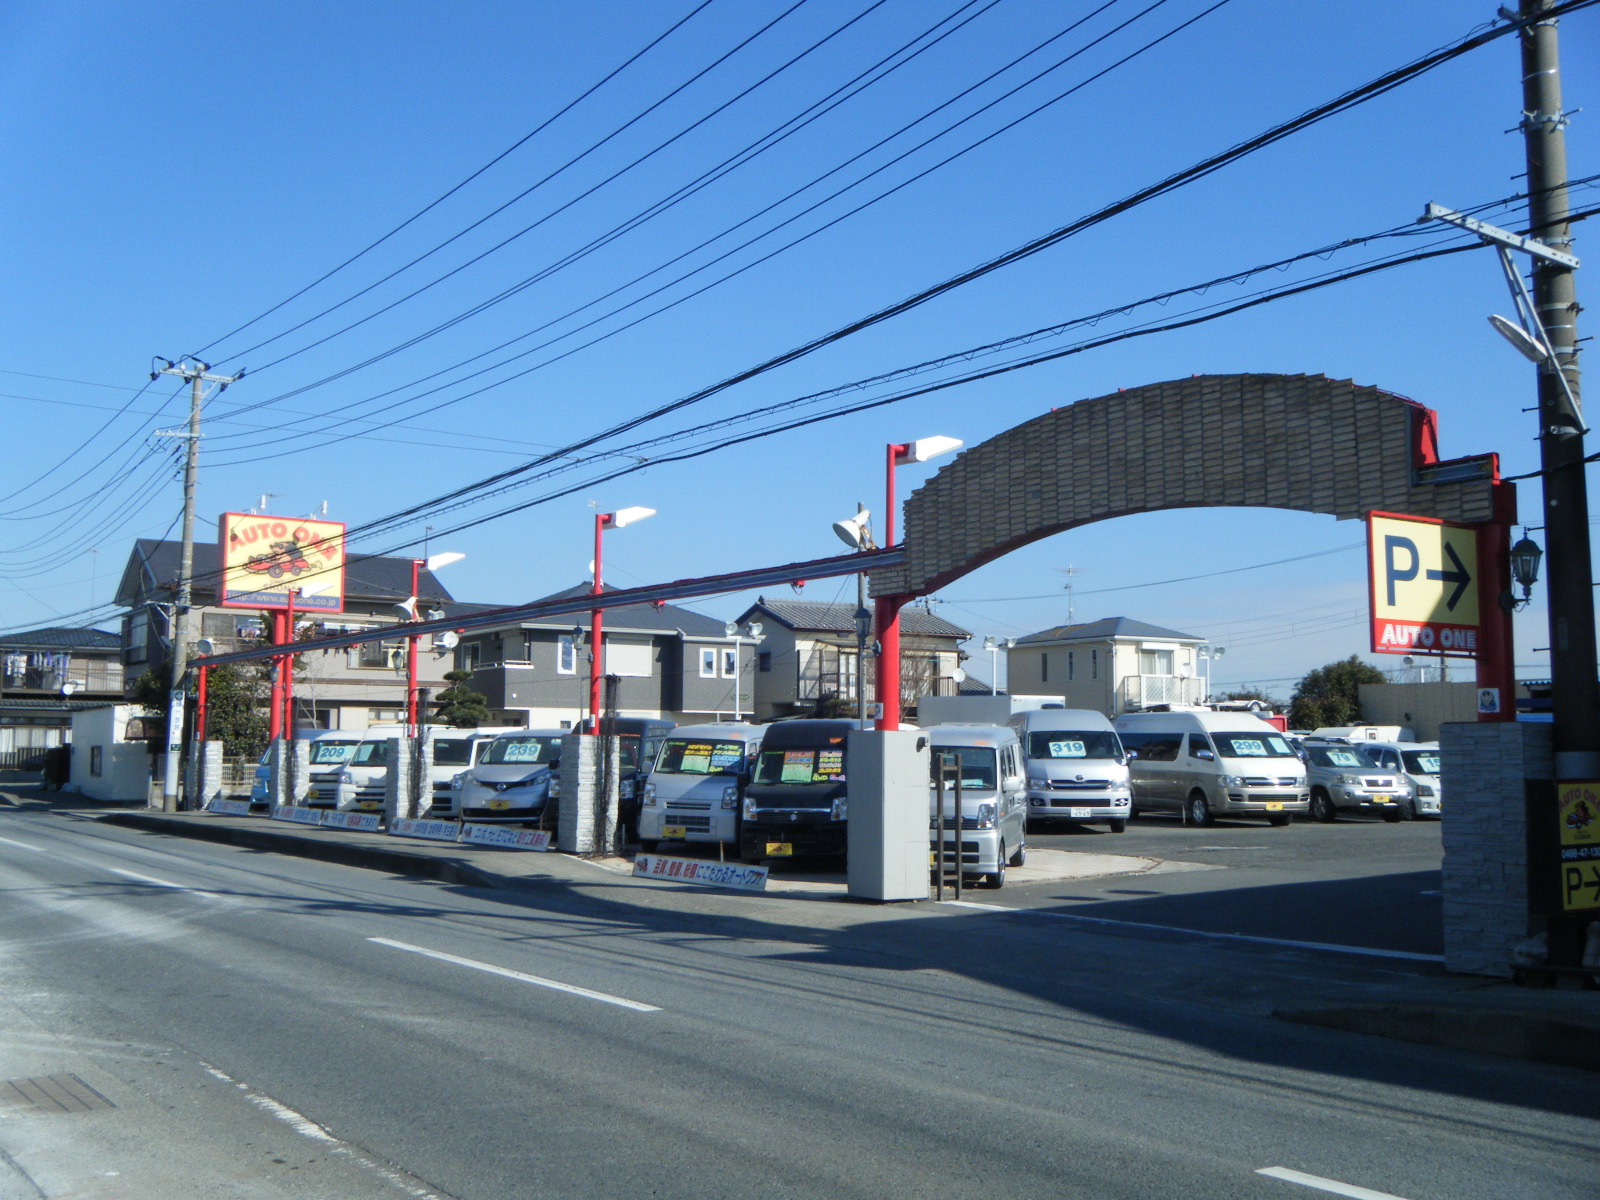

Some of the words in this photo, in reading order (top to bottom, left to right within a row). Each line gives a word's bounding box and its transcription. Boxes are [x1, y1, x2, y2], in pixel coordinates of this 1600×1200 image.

[229, 523, 288, 554] AUTO
[292, 526, 339, 561] ONE
[1384, 534, 1420, 607] P
[1381, 623, 1435, 647] AUTO
[1440, 627, 1477, 649] ONE
[507, 744, 539, 756] 239
[1051, 742, 1083, 753] 319
[1233, 740, 1262, 750] 299
[320, 747, 346, 758] 209
[1332, 753, 1351, 762] 79
[1566, 867, 1583, 905] P
